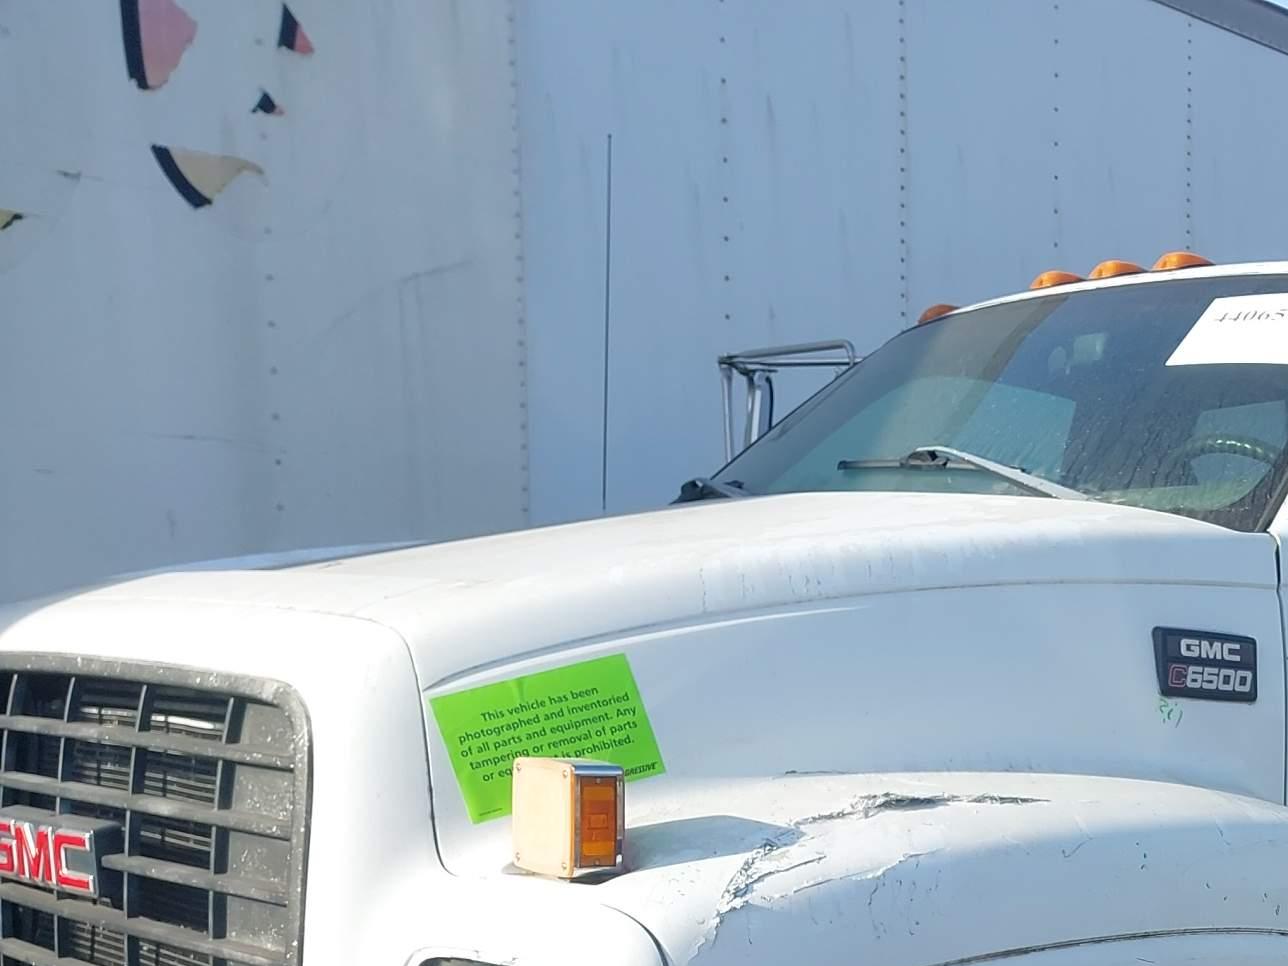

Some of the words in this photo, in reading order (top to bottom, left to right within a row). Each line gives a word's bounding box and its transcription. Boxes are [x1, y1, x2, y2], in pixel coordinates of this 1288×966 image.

[1181, 638, 1241, 661] GMC
[1168, 664, 1252, 692] C6500
[459, 714, 541, 745] photographed
[544, 707, 565, 721] and
[567, 691, 629, 715] inventoried
[481, 710, 505, 721] This
[507, 700, 546, 715] vehicle
[548, 695, 569, 705] has
[570, 687, 599, 700] been
[461, 746, 474, 758] of
[477, 741, 491, 754] all
[494, 734, 523, 752] parts
[526, 727, 547, 741] and
[550, 712, 613, 734] equipment.
[616, 706, 637, 718] Any
[470, 748, 530, 771] tampering
[532, 744, 545, 754] or
[547, 729, 593, 750] removal
[595, 725, 607, 738] of
[610, 720, 638, 736] parts
[483, 771, 495, 782] or
[574, 733, 635, 758] prohibited.
